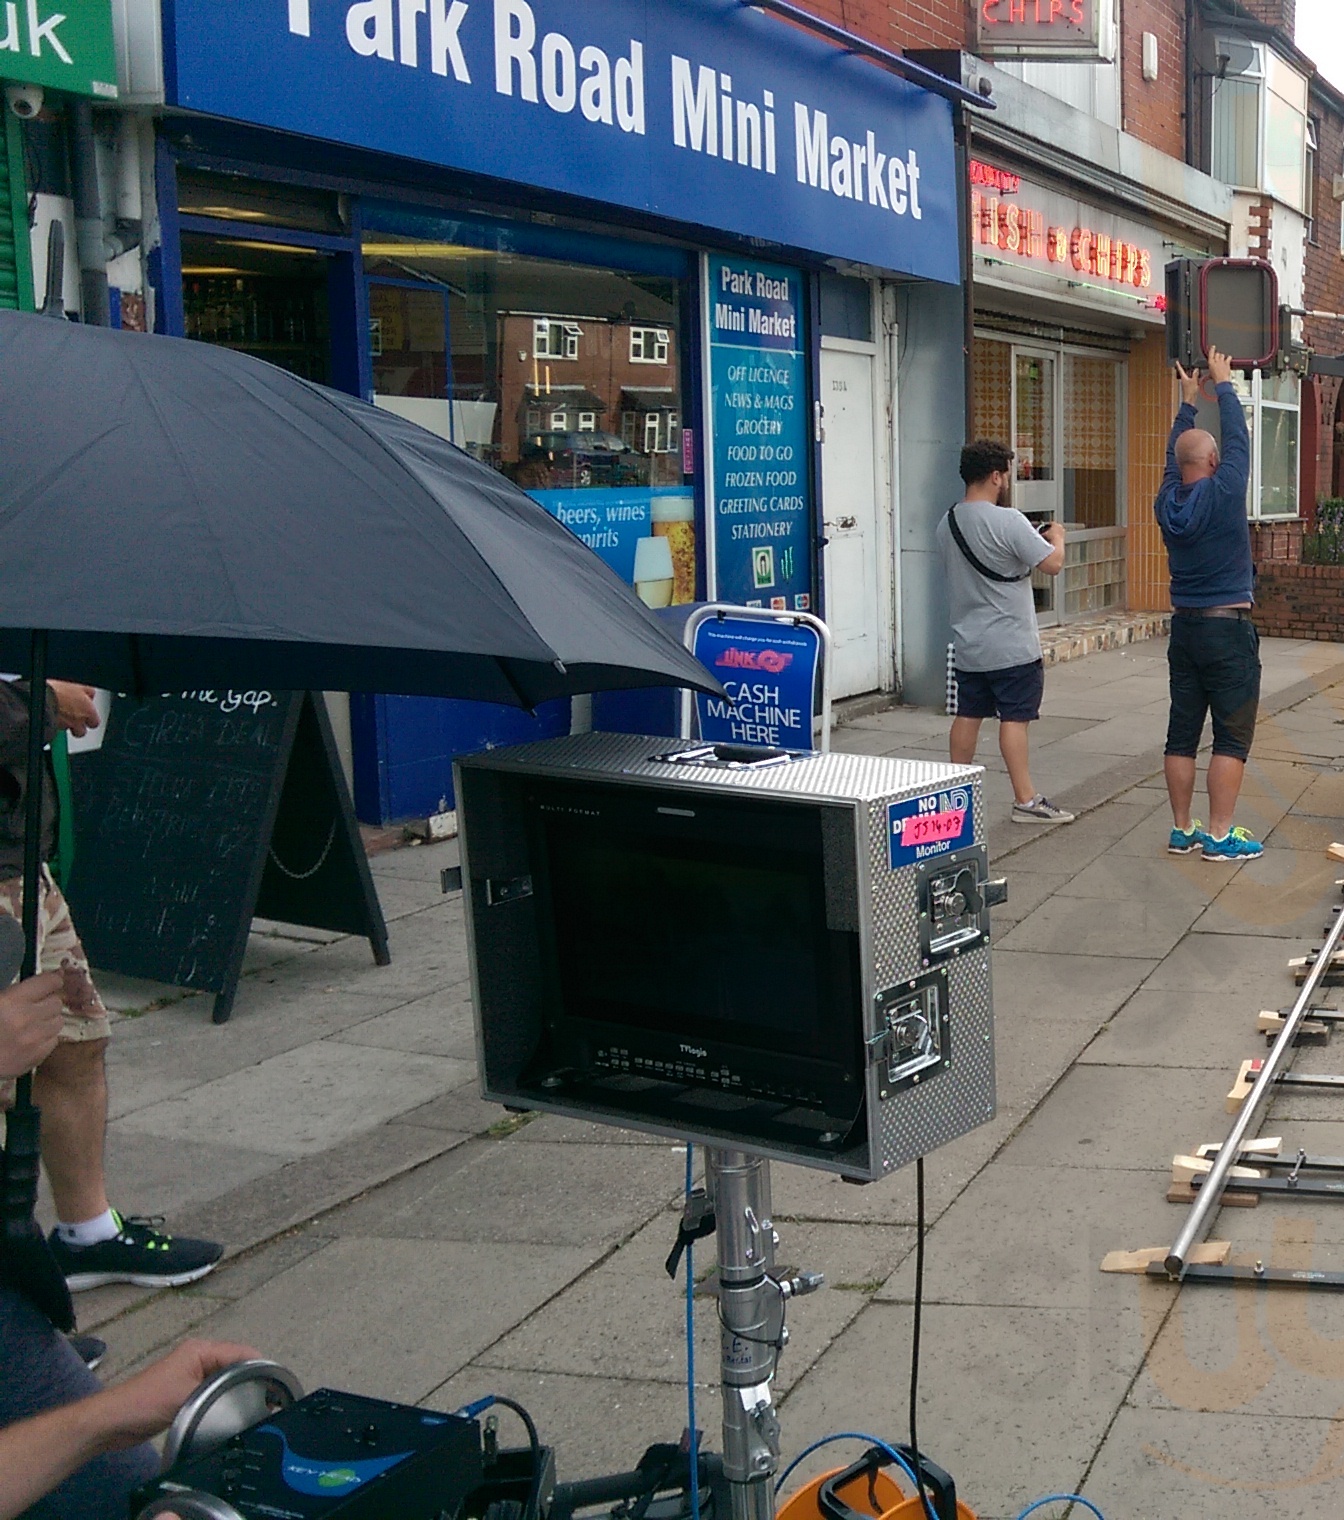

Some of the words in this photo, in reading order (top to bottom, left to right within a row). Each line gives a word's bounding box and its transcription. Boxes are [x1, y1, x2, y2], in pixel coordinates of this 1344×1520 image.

[982, 0, 1085, 23] CHIPS
[494, 0, 645, 135] Road
[671, 54, 776, 175] Mini
[794, 101, 922, 220] Market
[972, 190, 1043, 257] FISH
[1071, 227, 1151, 287] CHIPS
[721, 265, 752, 297] Park
[756, 272, 789, 300] Road
[715, 303, 745, 332] Mini
[748, 309, 796, 339] Market
[727, 365, 748, 382] OFF
[749, 367, 790, 385] LICENCE
[725, 393, 752, 409] NEWS
[753, 394, 763, 410] &
[764, 395, 794, 411] MAGS
[736, 419, 783, 436] GROCERY
[727, 445, 757, 461] FOOD
[760, 445, 773, 460] TO
[775, 446, 793, 461] GO
[725, 471, 763, 487] FROZEN
[766, 471, 796, 487] FOOD
[606, 500, 646, 521] wines
[719, 498, 768, 515] GREETING
[769, 496, 804, 512] CARDS
[731, 520, 793, 540] STATIONERY
[723, 681, 779, 705] CASH
[707, 699, 801, 728] MACHINE
[731, 722, 780, 745] HERE
[918, 796, 937, 813] NO
[916, 840, 951, 859] Monitor
